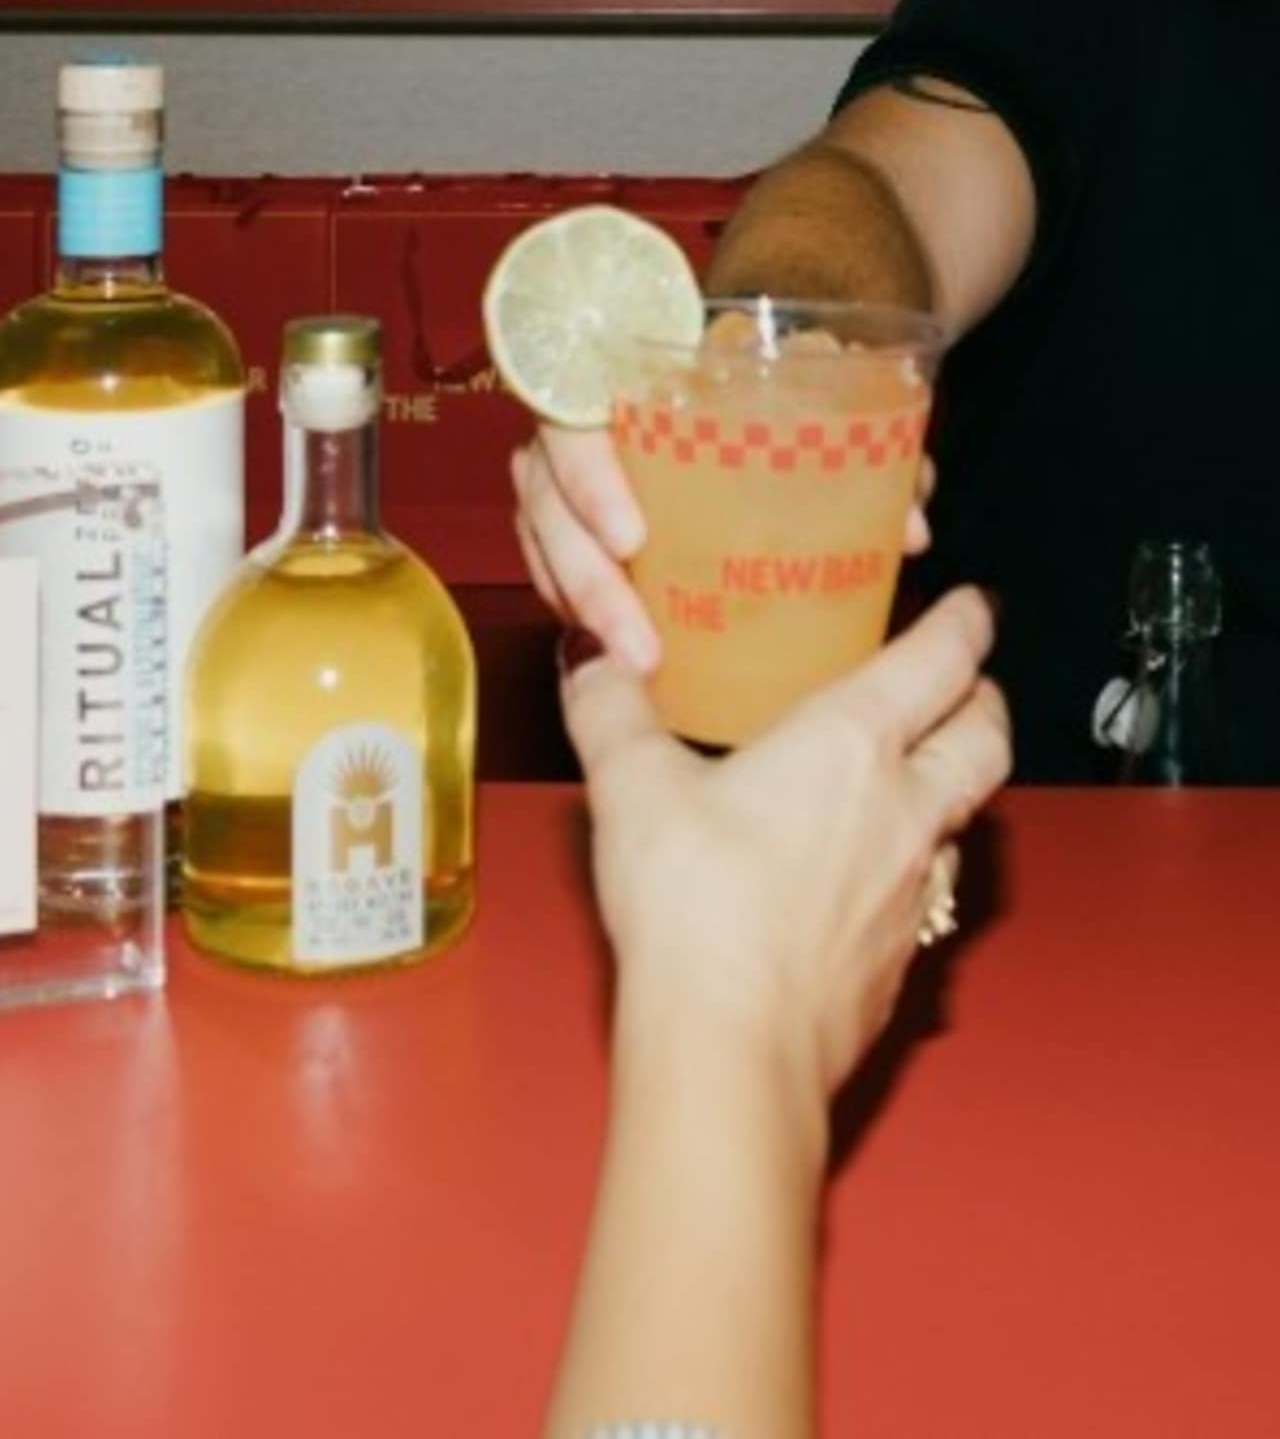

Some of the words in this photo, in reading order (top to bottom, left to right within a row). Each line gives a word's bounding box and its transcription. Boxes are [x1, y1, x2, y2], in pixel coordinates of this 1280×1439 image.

[387, 397, 438, 422] THE
[665, 583, 726, 633] THE
[723, 556, 816, 593] NEW
[76, 549, 124, 792] RITUAL
